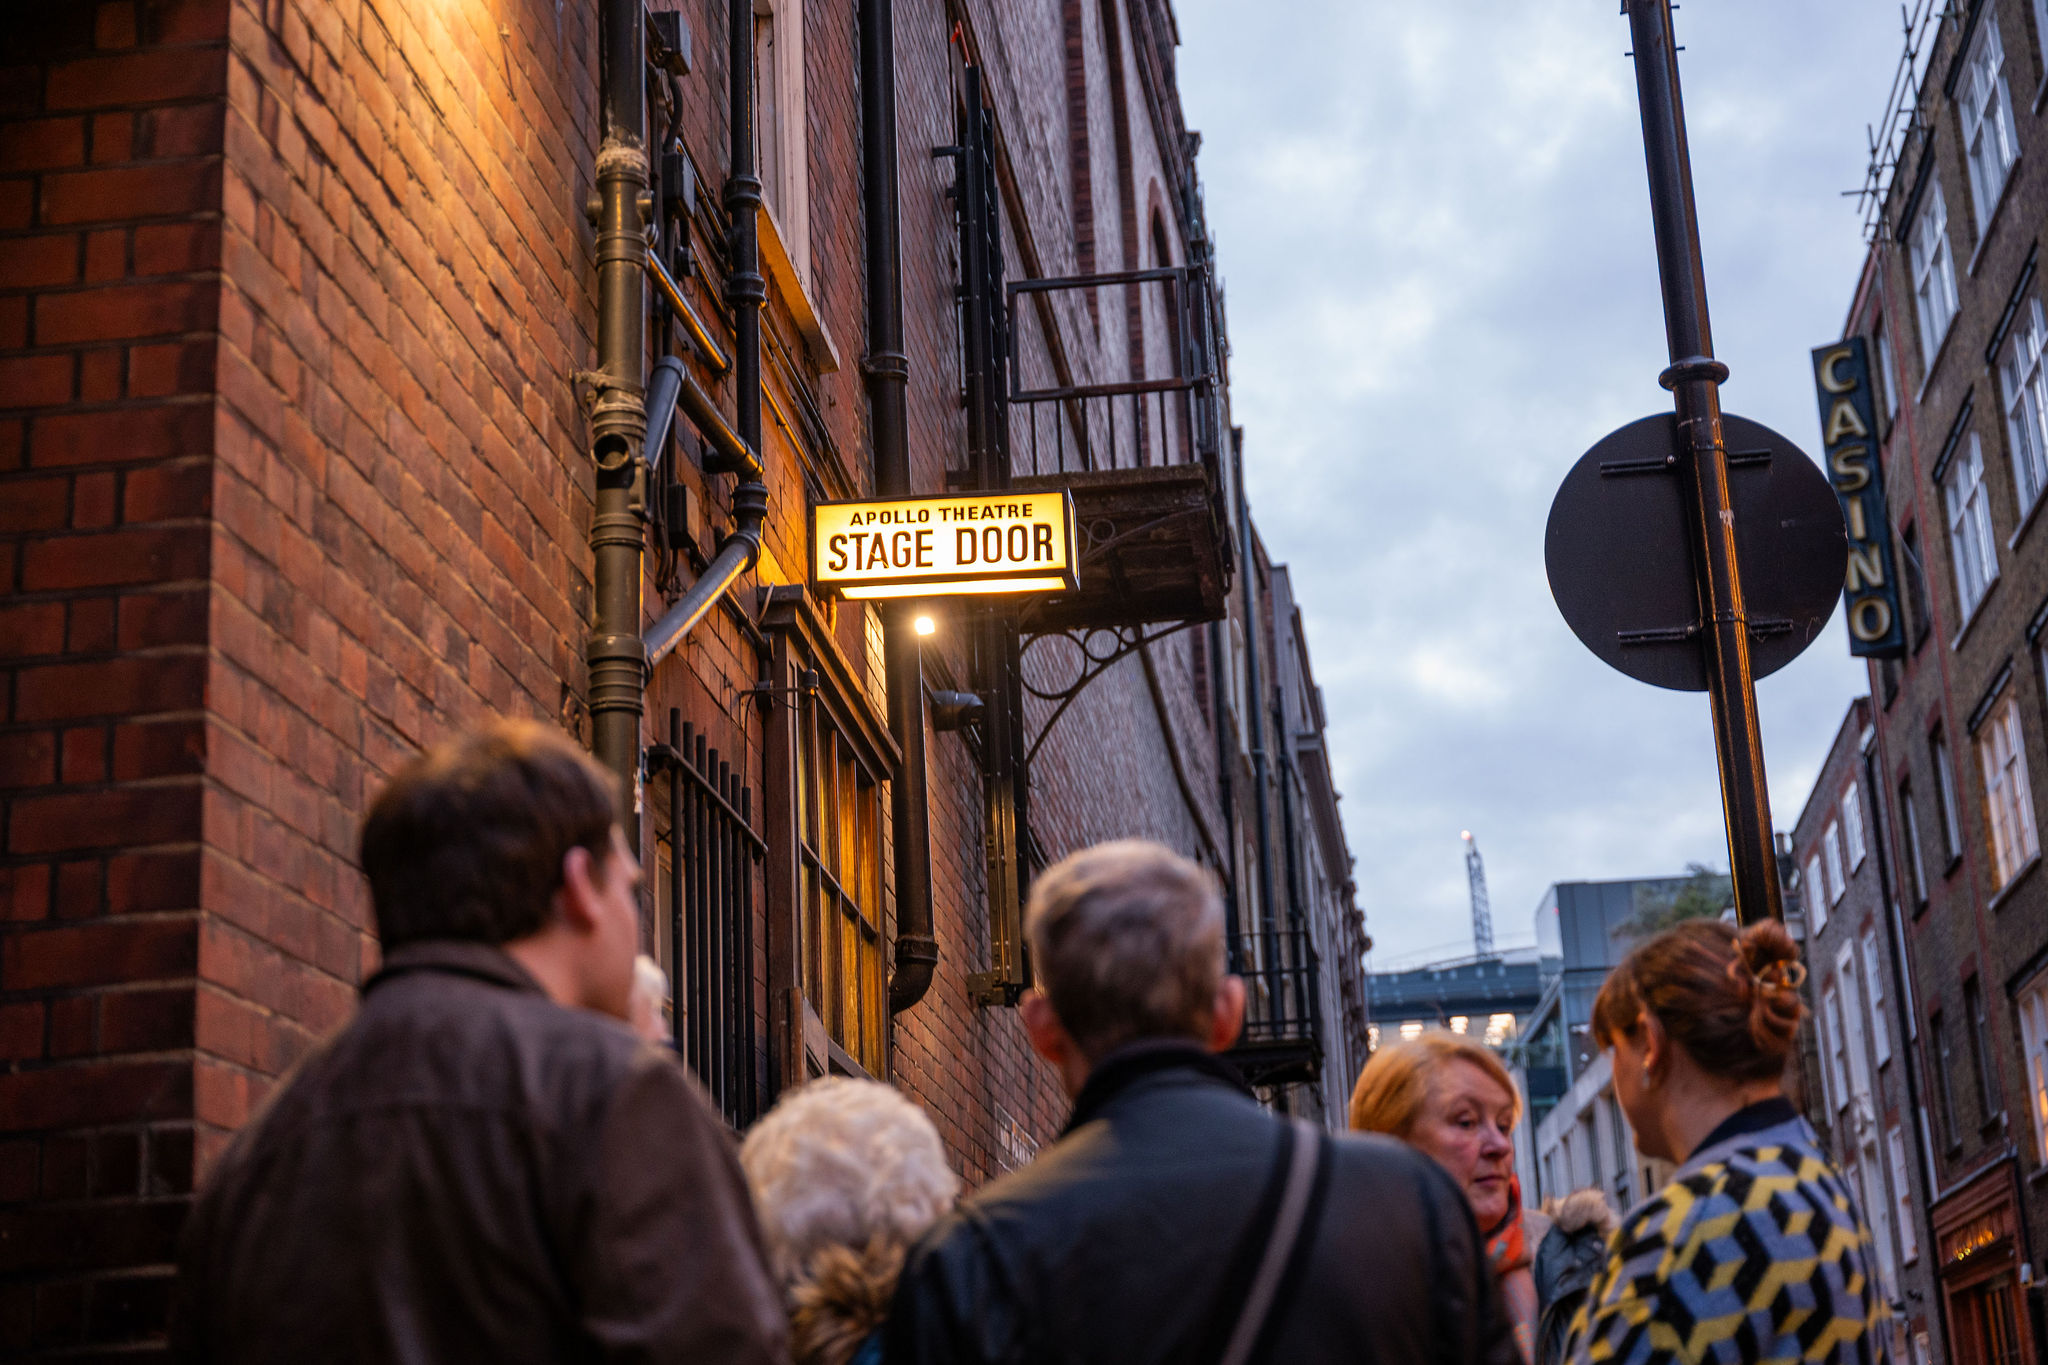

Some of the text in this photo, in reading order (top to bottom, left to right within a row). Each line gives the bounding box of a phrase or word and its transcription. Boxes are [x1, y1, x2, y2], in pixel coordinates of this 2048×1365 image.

[850, 503, 1033, 525] APOLLO THEATRE
[1819, 349, 1891, 641] CASINO
[828, 523, 1054, 571] STAGE DOOR
